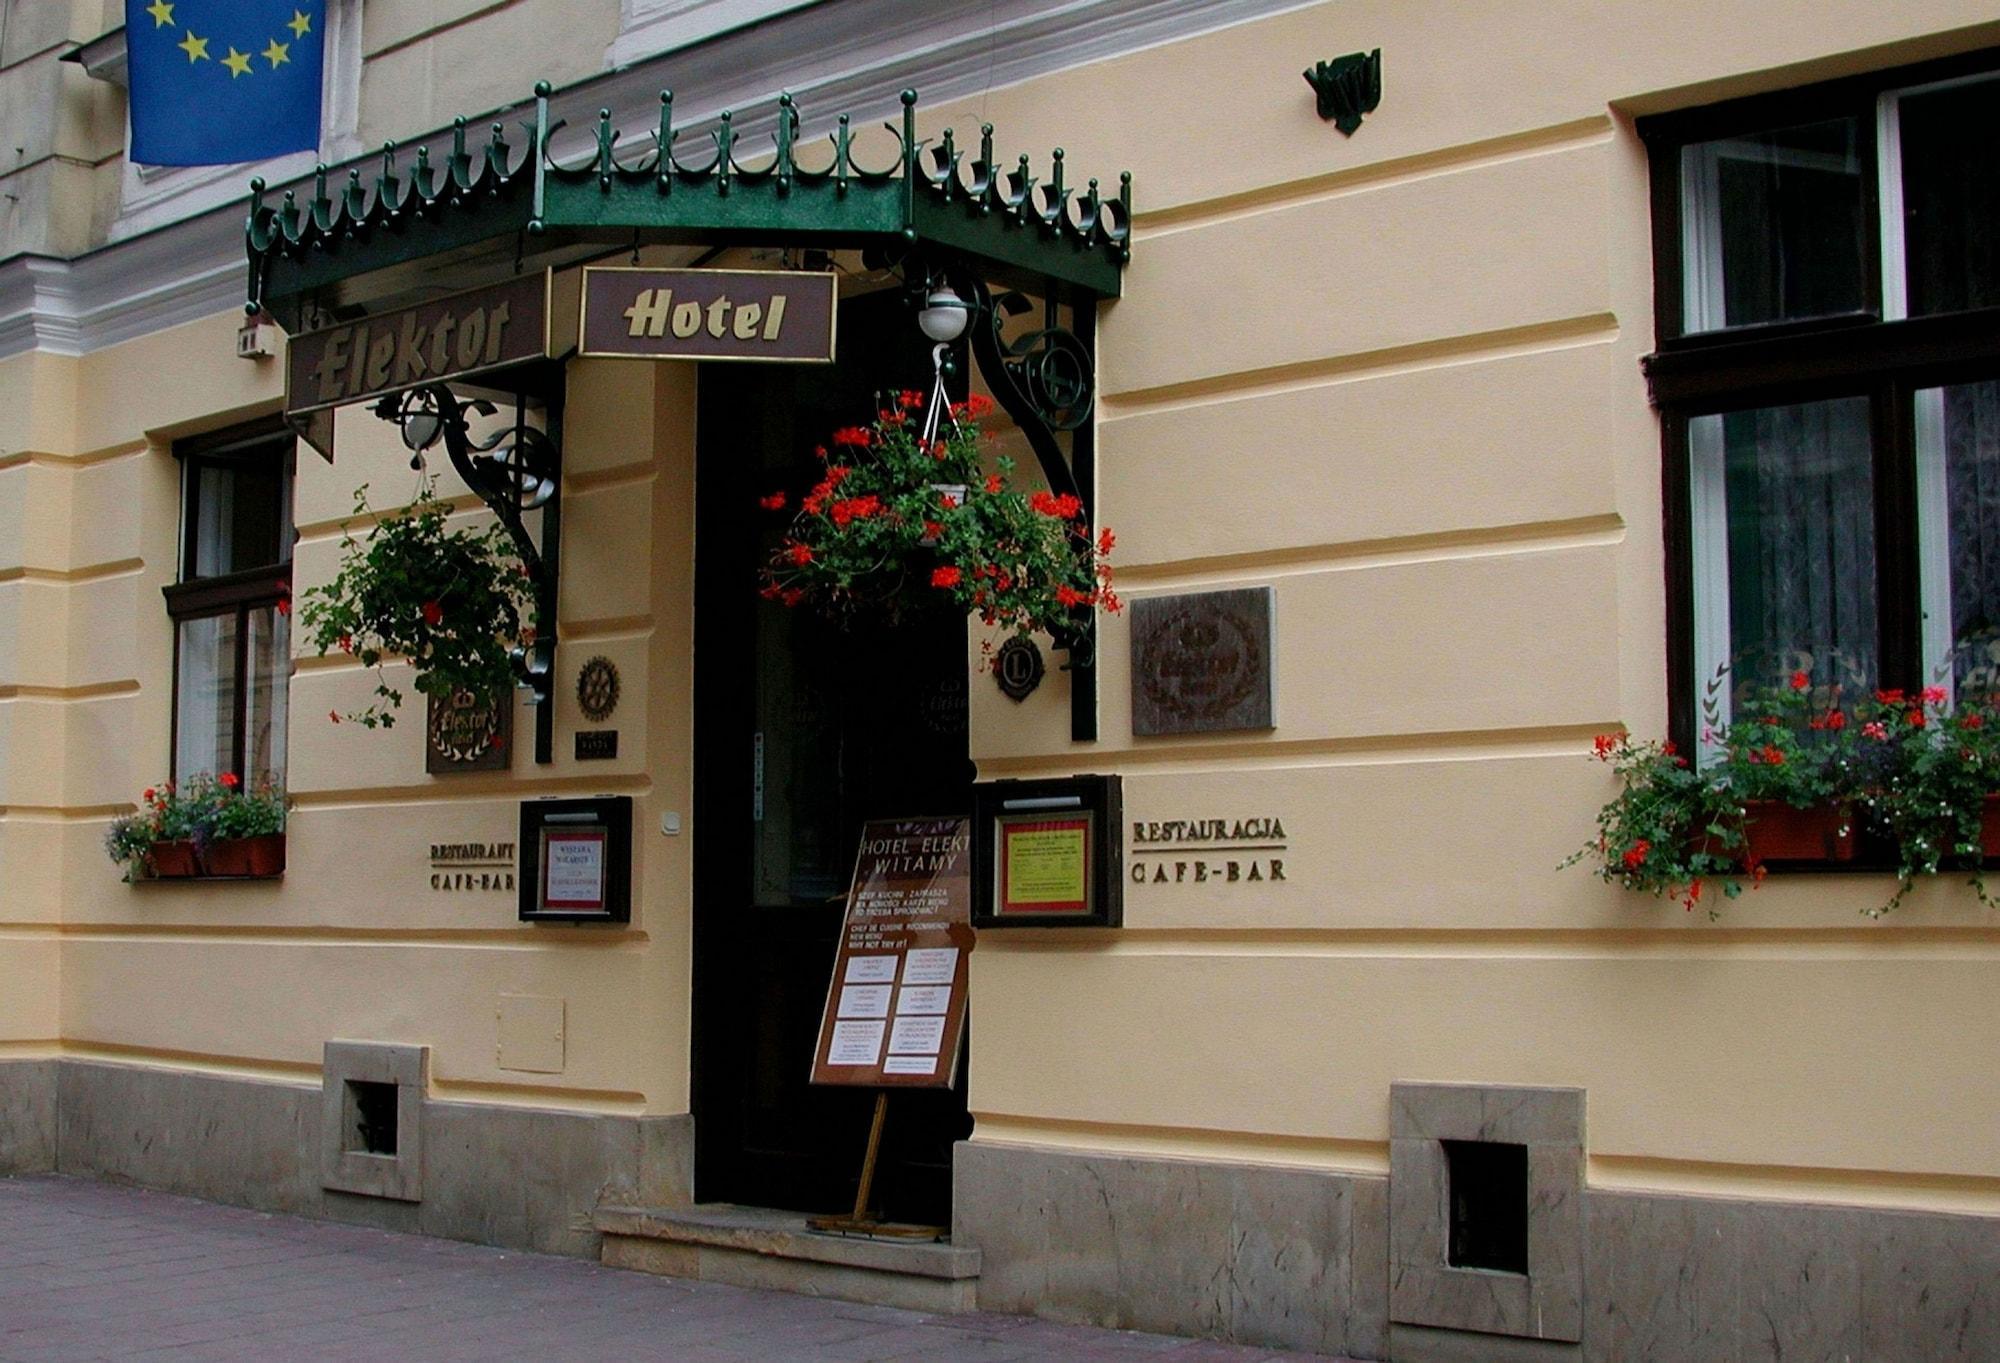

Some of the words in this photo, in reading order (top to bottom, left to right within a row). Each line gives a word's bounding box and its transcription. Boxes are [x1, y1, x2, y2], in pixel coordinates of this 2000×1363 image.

[623, 288, 787, 340] Hotel
[315, 300, 510, 402] Elektor
[1011, 653, 1027, 680] L
[1132, 817, 1287, 843] RESTAURACJA
[430, 843, 515, 859] RESTAURANT
[861, 839, 910, 856] HOTEL
[874, 854, 958, 875] WITAMY
[1131, 859, 1286, 883] CAFE-BAR
[430, 873, 515, 891] CAFE-BAR
